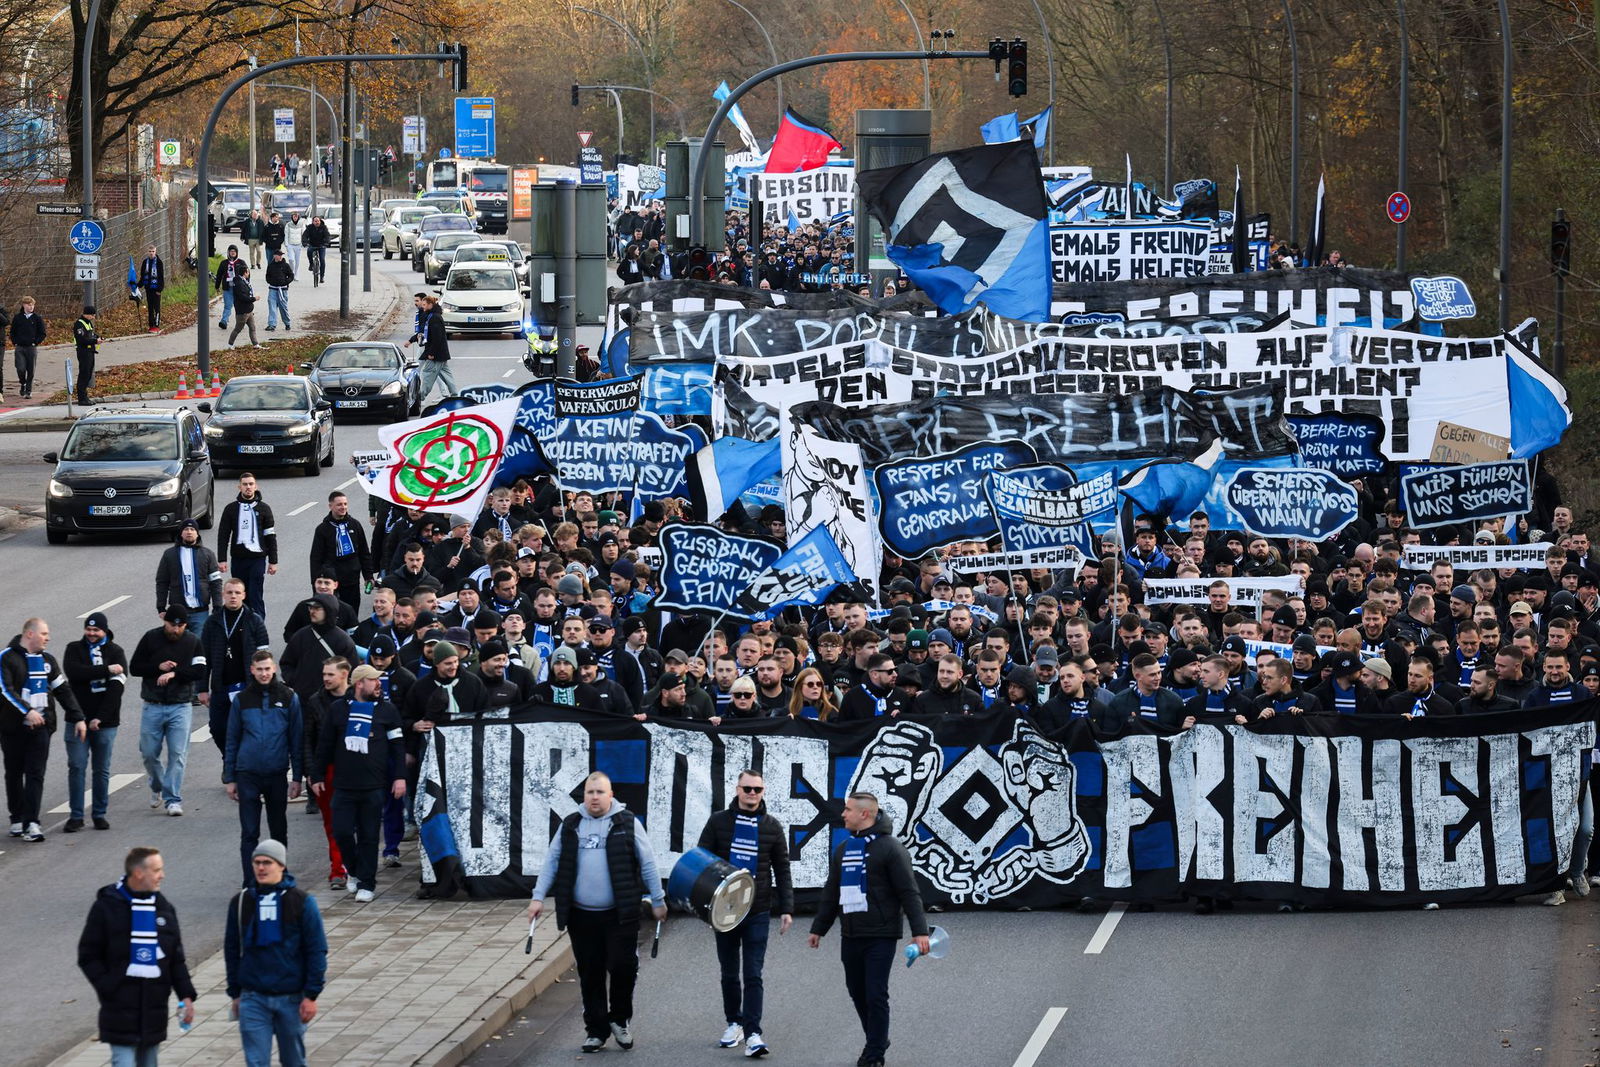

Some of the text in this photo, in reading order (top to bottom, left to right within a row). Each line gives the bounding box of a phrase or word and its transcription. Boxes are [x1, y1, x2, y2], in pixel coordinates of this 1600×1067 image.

[750, 172, 855, 200] PERSON
[39, 205, 82, 214] Ottensener Straße
[1051, 230, 1208, 256] EMALS FREUND
[1051, 257, 1207, 282] EMALS HELFER
[1414, 279, 1457, 293] FREIHEIT
[1421, 290, 1457, 302] STIRBT
[1418, 303, 1474, 317] SICHERHEIT
[1430, 299, 1452, 309] MIT
[891, 340, 1228, 384] STADIONVERBOTEN
[1256, 333, 1328, 368] AUF
[556, 378, 640, 400] PETERWAGEN
[815, 371, 888, 403] DEN
[516, 403, 556, 427] STAD
[558, 395, 637, 415] VAFFANCULO
[574, 416, 646, 439] KEINE
[1439, 425, 1476, 443] GEGEN
[1345, 443, 1362, 457] IN
[560, 461, 672, 491] GEGEN FANS!
[884, 452, 1007, 485] RESPEKT FÜR
[1303, 458, 1385, 473] EIN KAFF!
[1069, 471, 1114, 498] MUSS
[1251, 471, 1328, 492] SCHEISS
[1412, 465, 1523, 499] WIR FÜHLEN
[894, 482, 957, 511] FANS,
[993, 487, 1118, 520] BEZAHLBAR SEIN
[1413, 480, 1528, 518] UNS SICHER
[94, 506, 103, 515] HH
[117, 506, 131, 515] 969
[1254, 508, 1324, 536] WAHN!
[669, 530, 764, 568] FUSSBALL
[1007, 523, 1084, 551] STOPPEN
[673, 551, 736, 580] GEHÖRT
[736, 562, 764, 585] DE
[1407, 549, 1547, 566] POPULISMUS STOPPE
[1097, 722, 1597, 892] FREIHEIT
